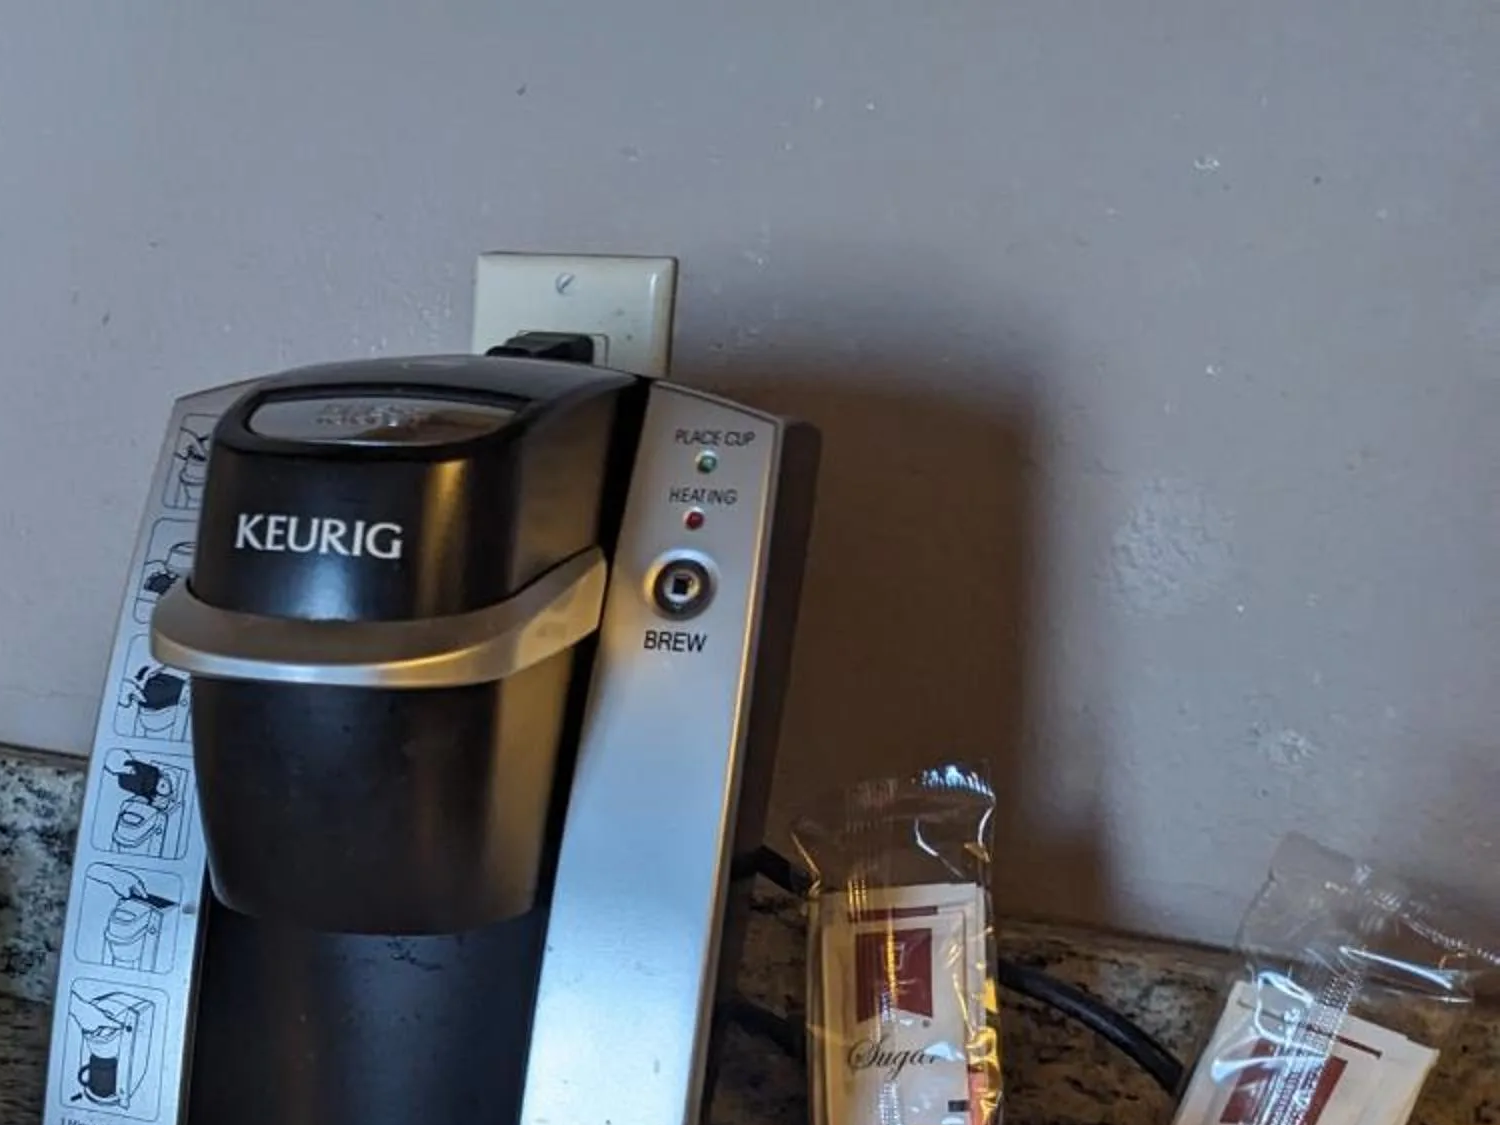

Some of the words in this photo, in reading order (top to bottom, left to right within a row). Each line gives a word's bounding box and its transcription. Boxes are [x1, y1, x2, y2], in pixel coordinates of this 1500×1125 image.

[675, 428, 722, 447] PLACE
[723, 430, 756, 448] CUP
[669, 487, 738, 506] HEATING
[235, 512, 404, 560] KEURIG
[644, 630, 708, 653] BREW
[847, 1032, 942, 1081] Sugar
